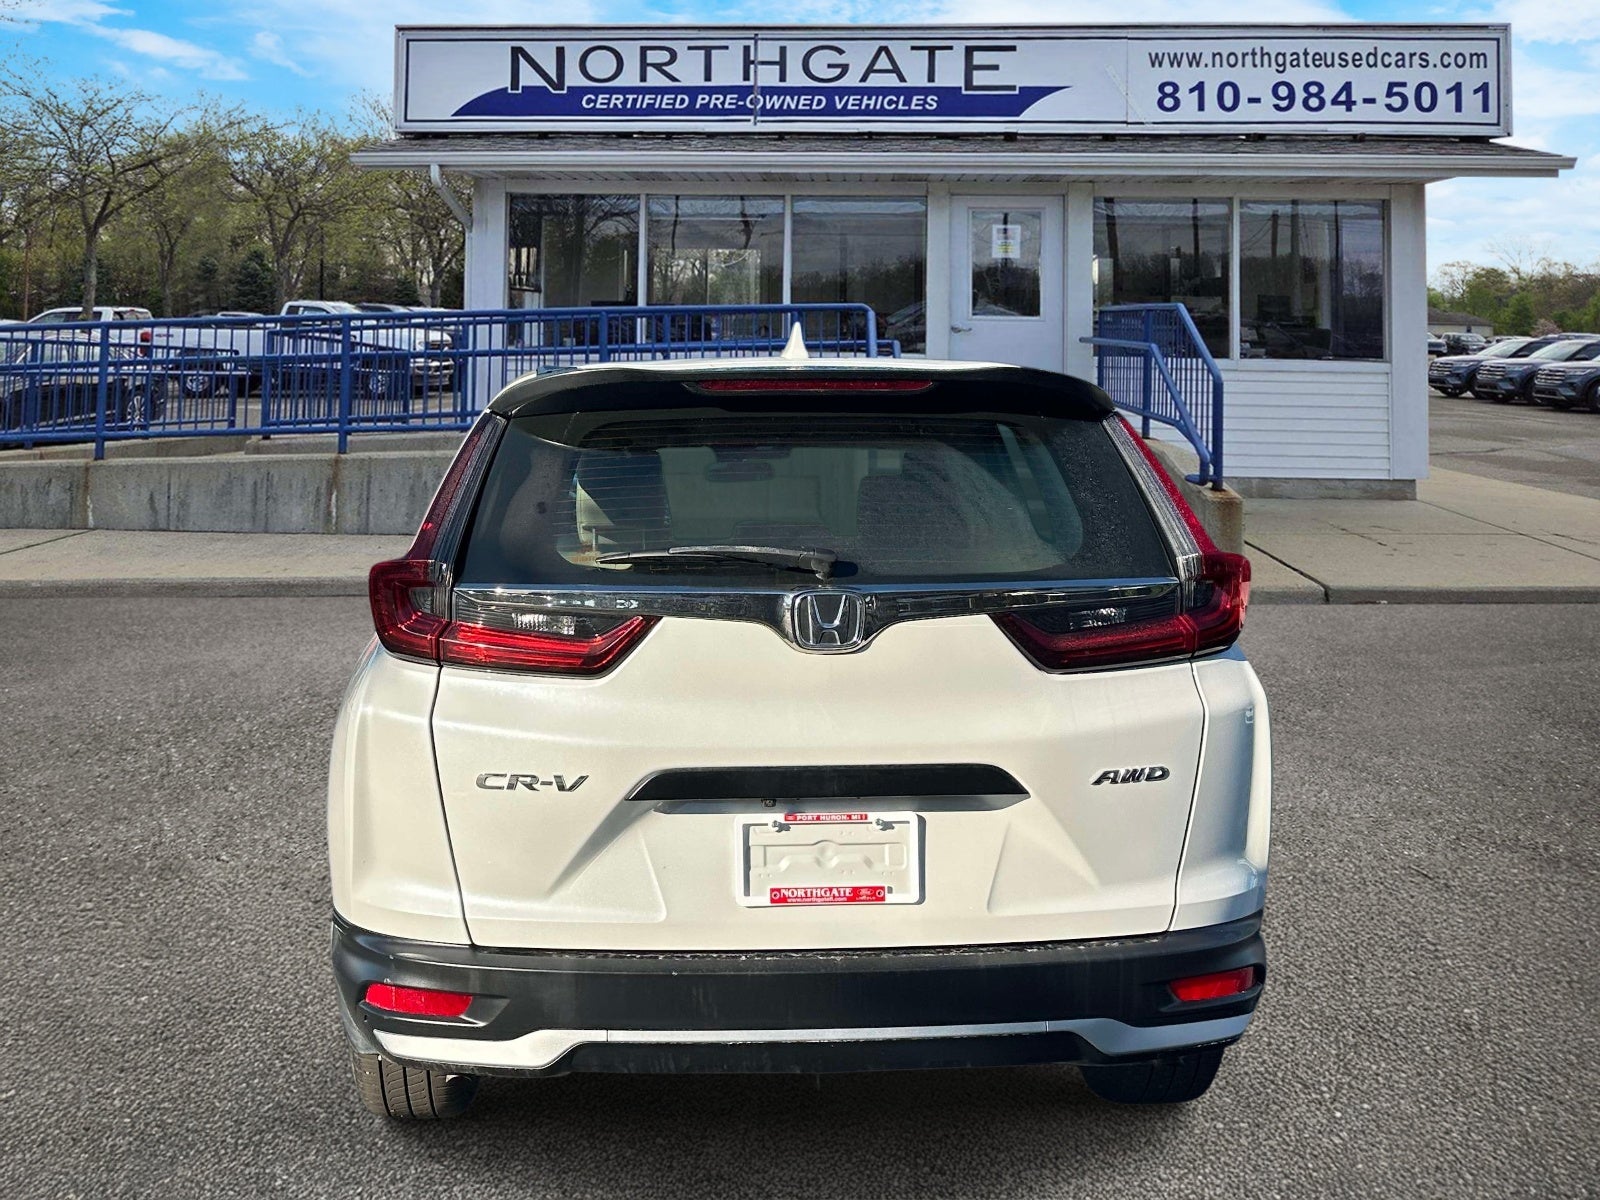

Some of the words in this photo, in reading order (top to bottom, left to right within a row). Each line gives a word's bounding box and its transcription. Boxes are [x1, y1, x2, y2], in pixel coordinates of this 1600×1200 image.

[510, 44, 1018, 92] NORTHGATE
[1148, 46, 1489, 73] www.northgateusedcars.com
[581, 94, 690, 109] CERTIFIED
[695, 94, 827, 110] PRE-OWNED
[834, 94, 939, 111] VEHICLES
[1156, 80, 1491, 113] 810-984-5011
[475, 773, 589, 792] CR-V
[1090, 765, 1170, 785] AWD
[780, 888, 853, 897] NORTHGATE
